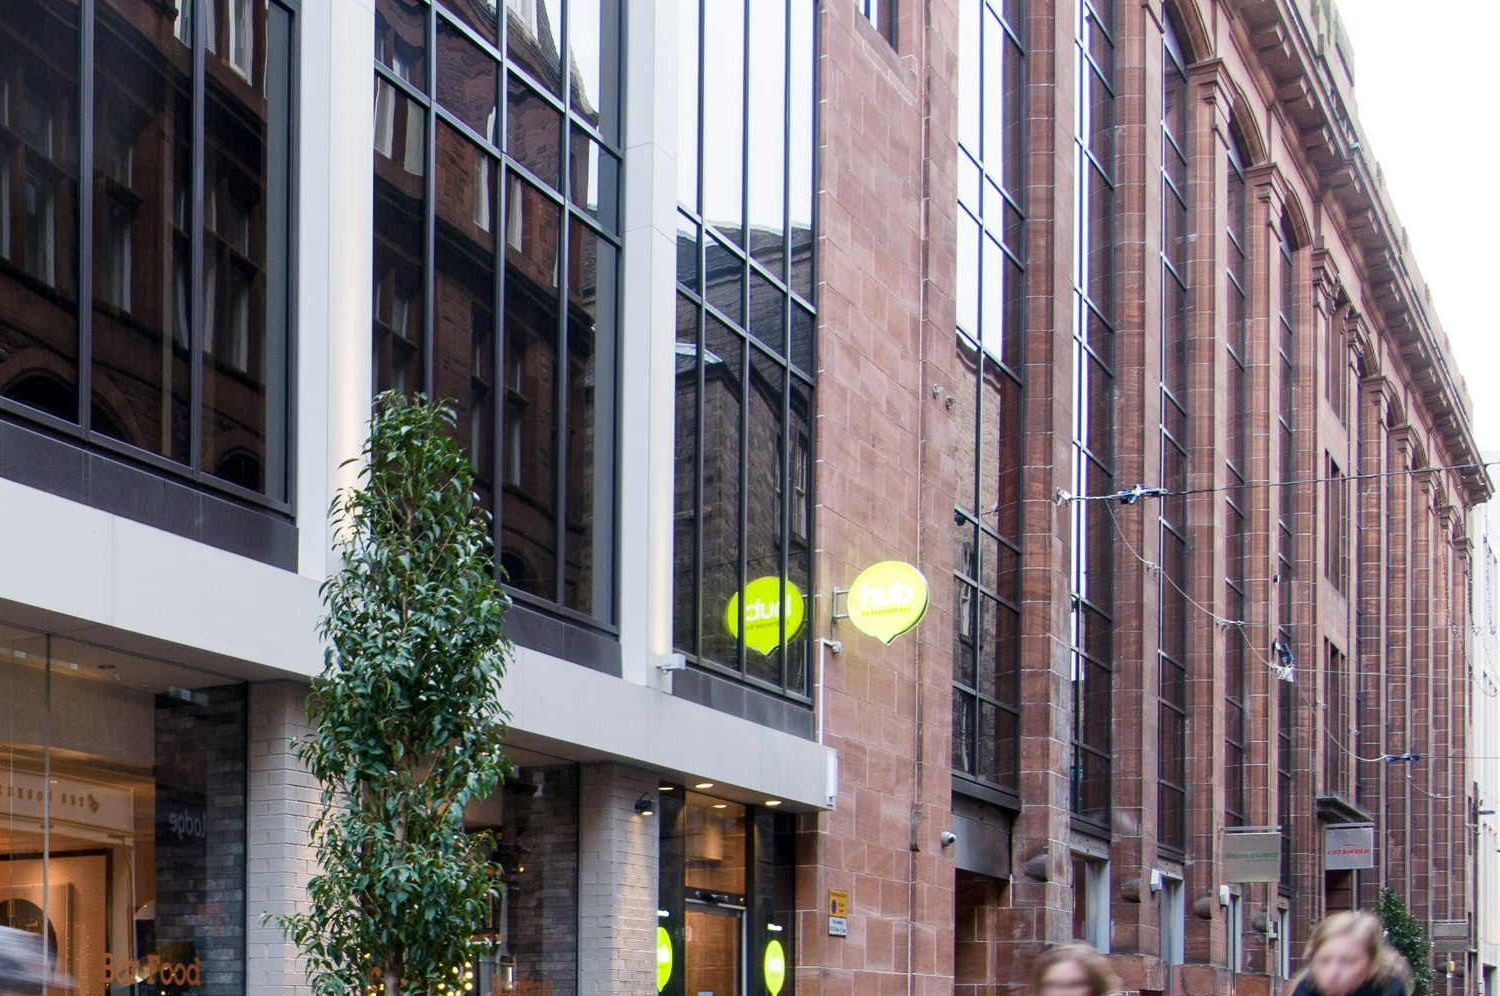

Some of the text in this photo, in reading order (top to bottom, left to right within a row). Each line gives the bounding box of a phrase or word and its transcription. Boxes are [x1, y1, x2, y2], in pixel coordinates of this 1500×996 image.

[861, 580, 913, 608] hub
[103, 953, 201, 986] Bar Food
